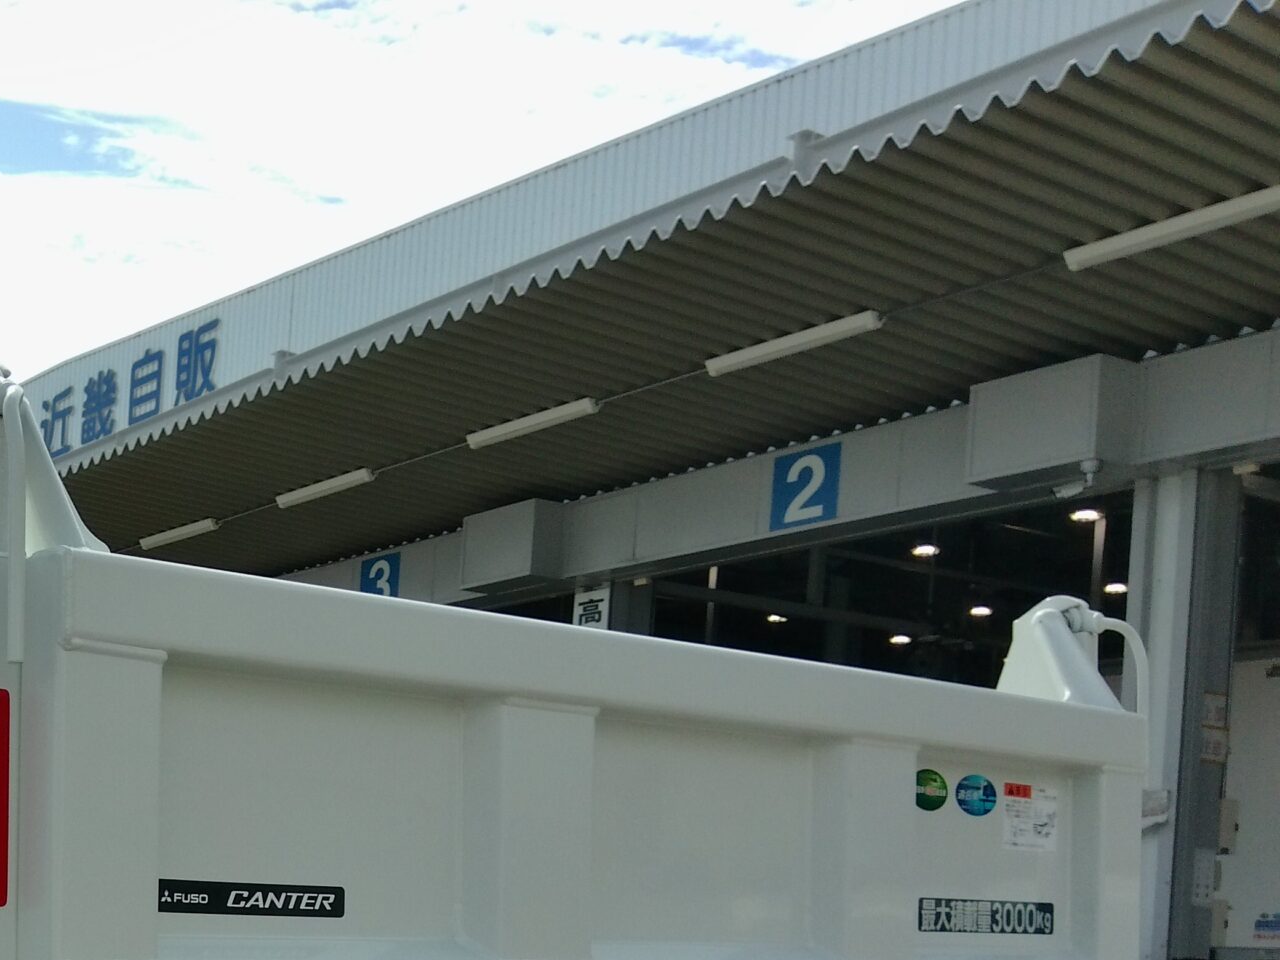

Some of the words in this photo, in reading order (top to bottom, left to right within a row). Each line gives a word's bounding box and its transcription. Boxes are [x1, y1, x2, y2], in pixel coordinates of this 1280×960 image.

[40, 319, 219, 458] 近畿自販
[783, 454, 825, 524] 2
[369, 559, 391, 597] 3
[173, 892, 208, 904] FUSO
[226, 890, 336, 911] CANTER
